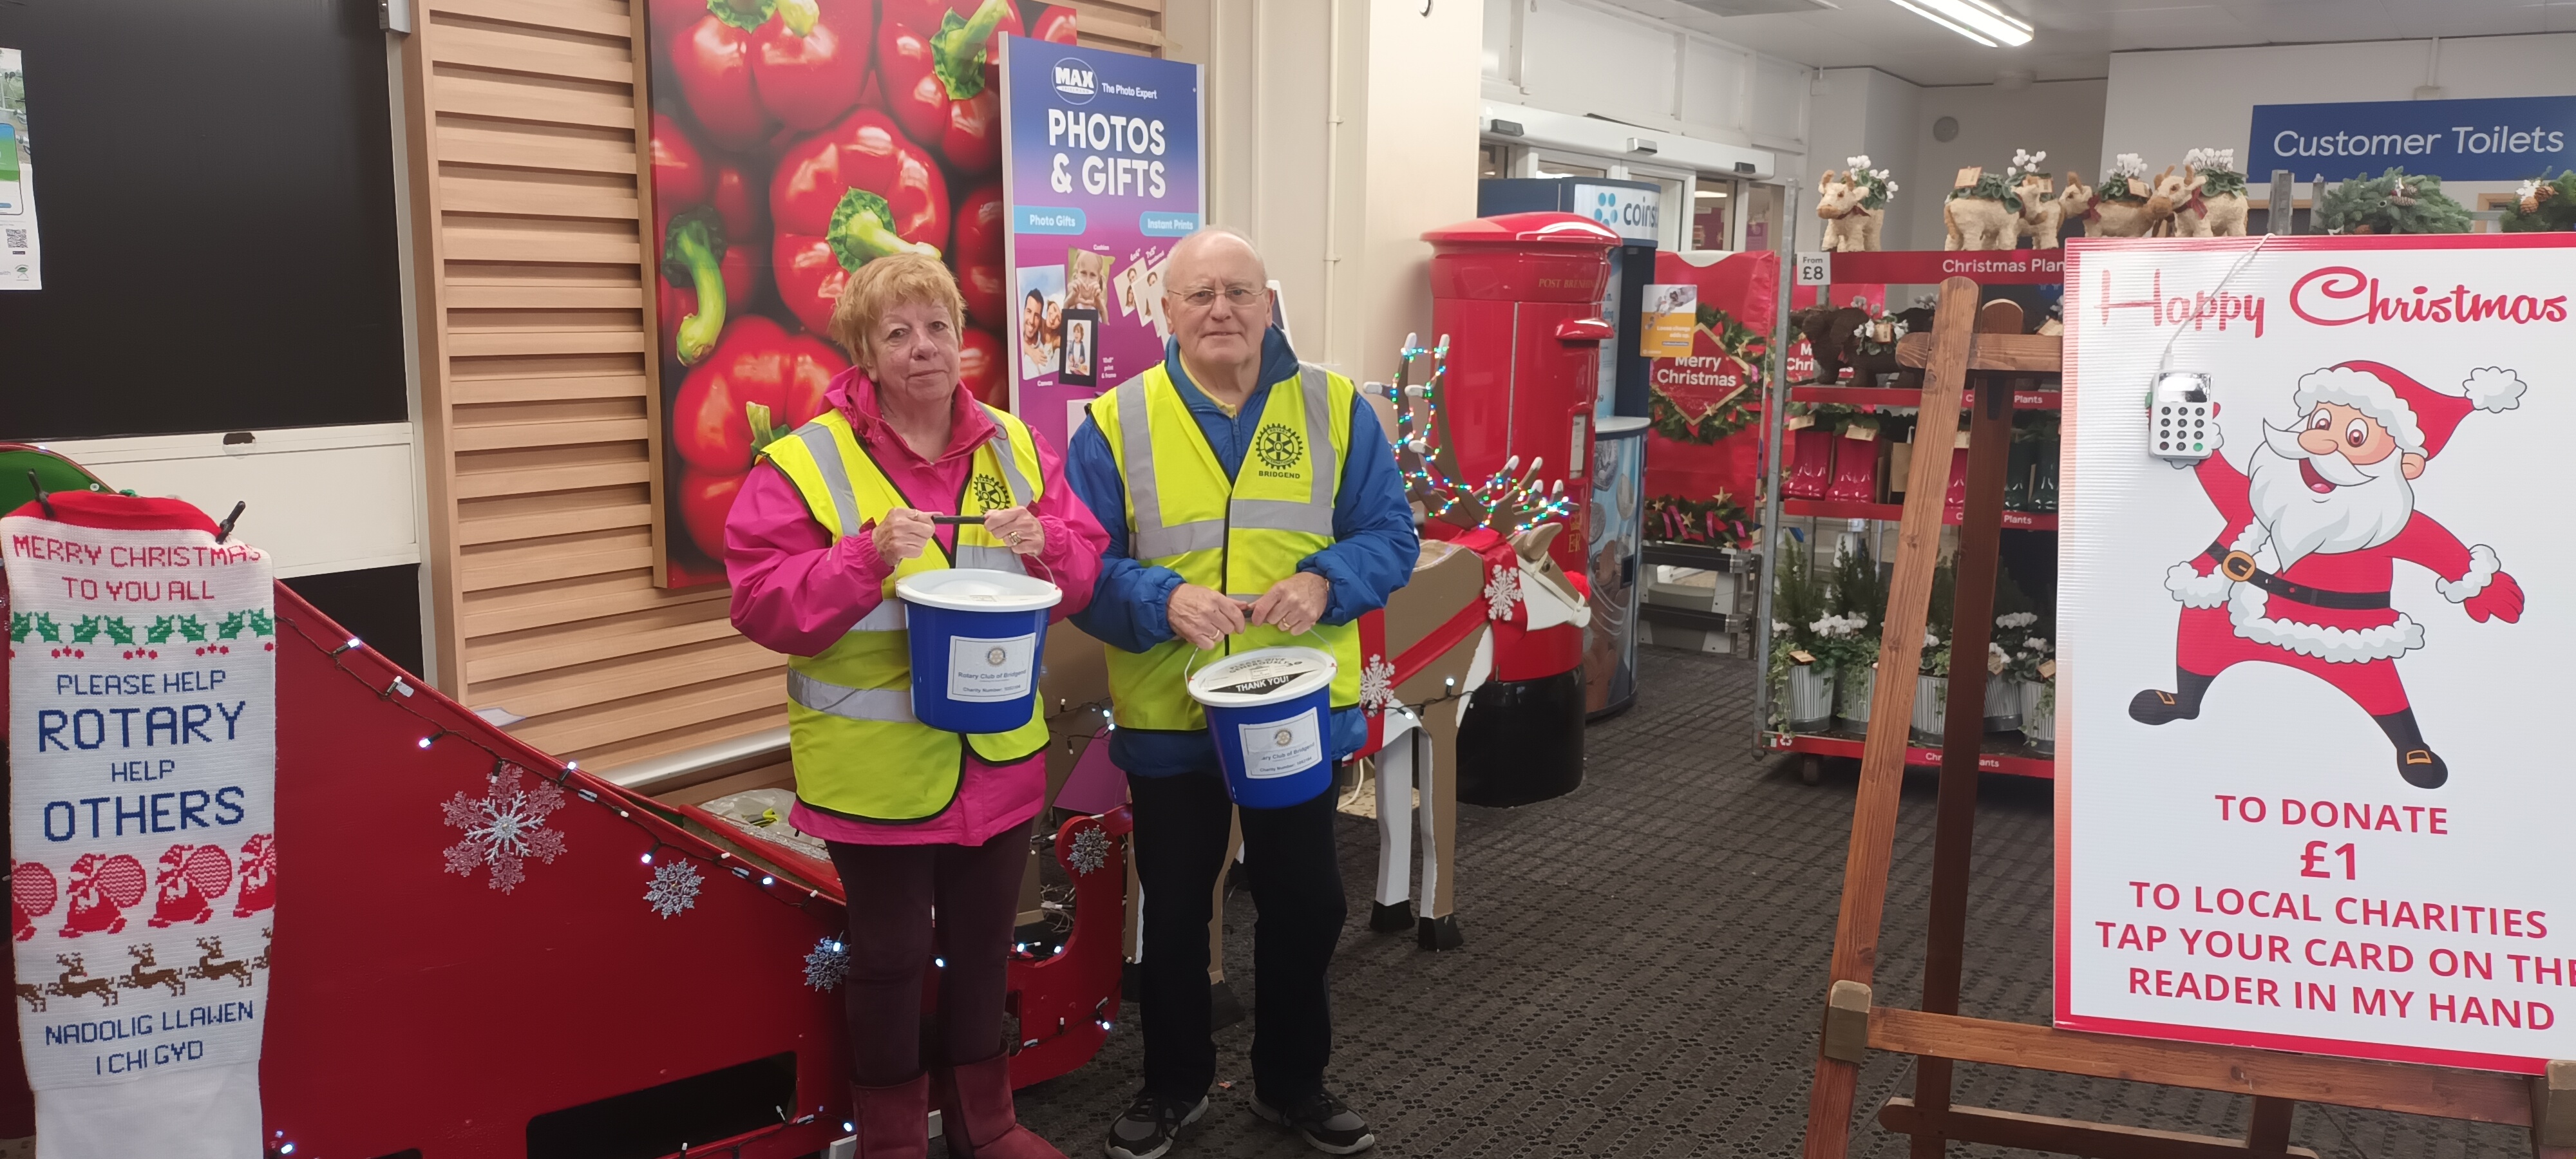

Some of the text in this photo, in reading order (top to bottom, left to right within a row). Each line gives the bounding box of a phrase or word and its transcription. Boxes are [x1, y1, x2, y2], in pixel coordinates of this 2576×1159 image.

[1055, 67, 1094, 89] MAX
[1102, 82, 1158, 100] The Photo Expert
[1048, 108, 1166, 156] PHOTOS
[2273, 125, 2565, 157] Customer Toilets
[1050, 153, 1166, 198] & GIFTS
[1029, 214, 1076, 228] Photo Gifts
[1147, 218, 1194, 231] Instant Prints
[1803, 265, 1824, 280] £8
[1942, 258, 2065, 274] Christmas Plan
[1538, 278, 1562, 288] POST
[2093, 265, 2568, 339] Happy Christmas
[1674, 356, 1721, 372] Merry
[1656, 368, 1737, 387] Christmas
[2014, 395, 2043, 405] Plants
[1258, 470, 1301, 479] BRIDGEND
[2003, 514, 2032, 525] Plants
[12, 534, 261, 568] MERRY CHRISTMAS
[62, 576, 215, 602] TO YOU ALL
[57, 670, 226, 695] PLEASE HELP
[958, 672, 979, 680] Rotary
[1003, 669, 1027, 678] Bridgend
[1236, 675, 1289, 692] THANK YOU!
[39, 700, 246, 753] ROTARY
[1293, 741, 1315, 755] Bridgend
[111, 759, 175, 782] HELP
[1979, 759, 2000, 768] ants
[44, 786, 245, 842] OTHERS
[2215, 794, 2448, 836] TO DONATE
[2300, 840, 2357, 881] £1
[2128, 881, 2548, 939] TO LOCAL CHARITIES
[2095, 921, 2168, 952] TAP
[2179, 927, 2292, 963] YOUR
[2304, 938, 2414, 973] CARD
[2428, 948, 2494, 981] ON
[2128, 967, 2555, 1031] READER IN MY HAND
[45, 1000, 254, 1046] NADOLIG LLAWEN
[96, 1040, 204, 1075] I CHI GYD
